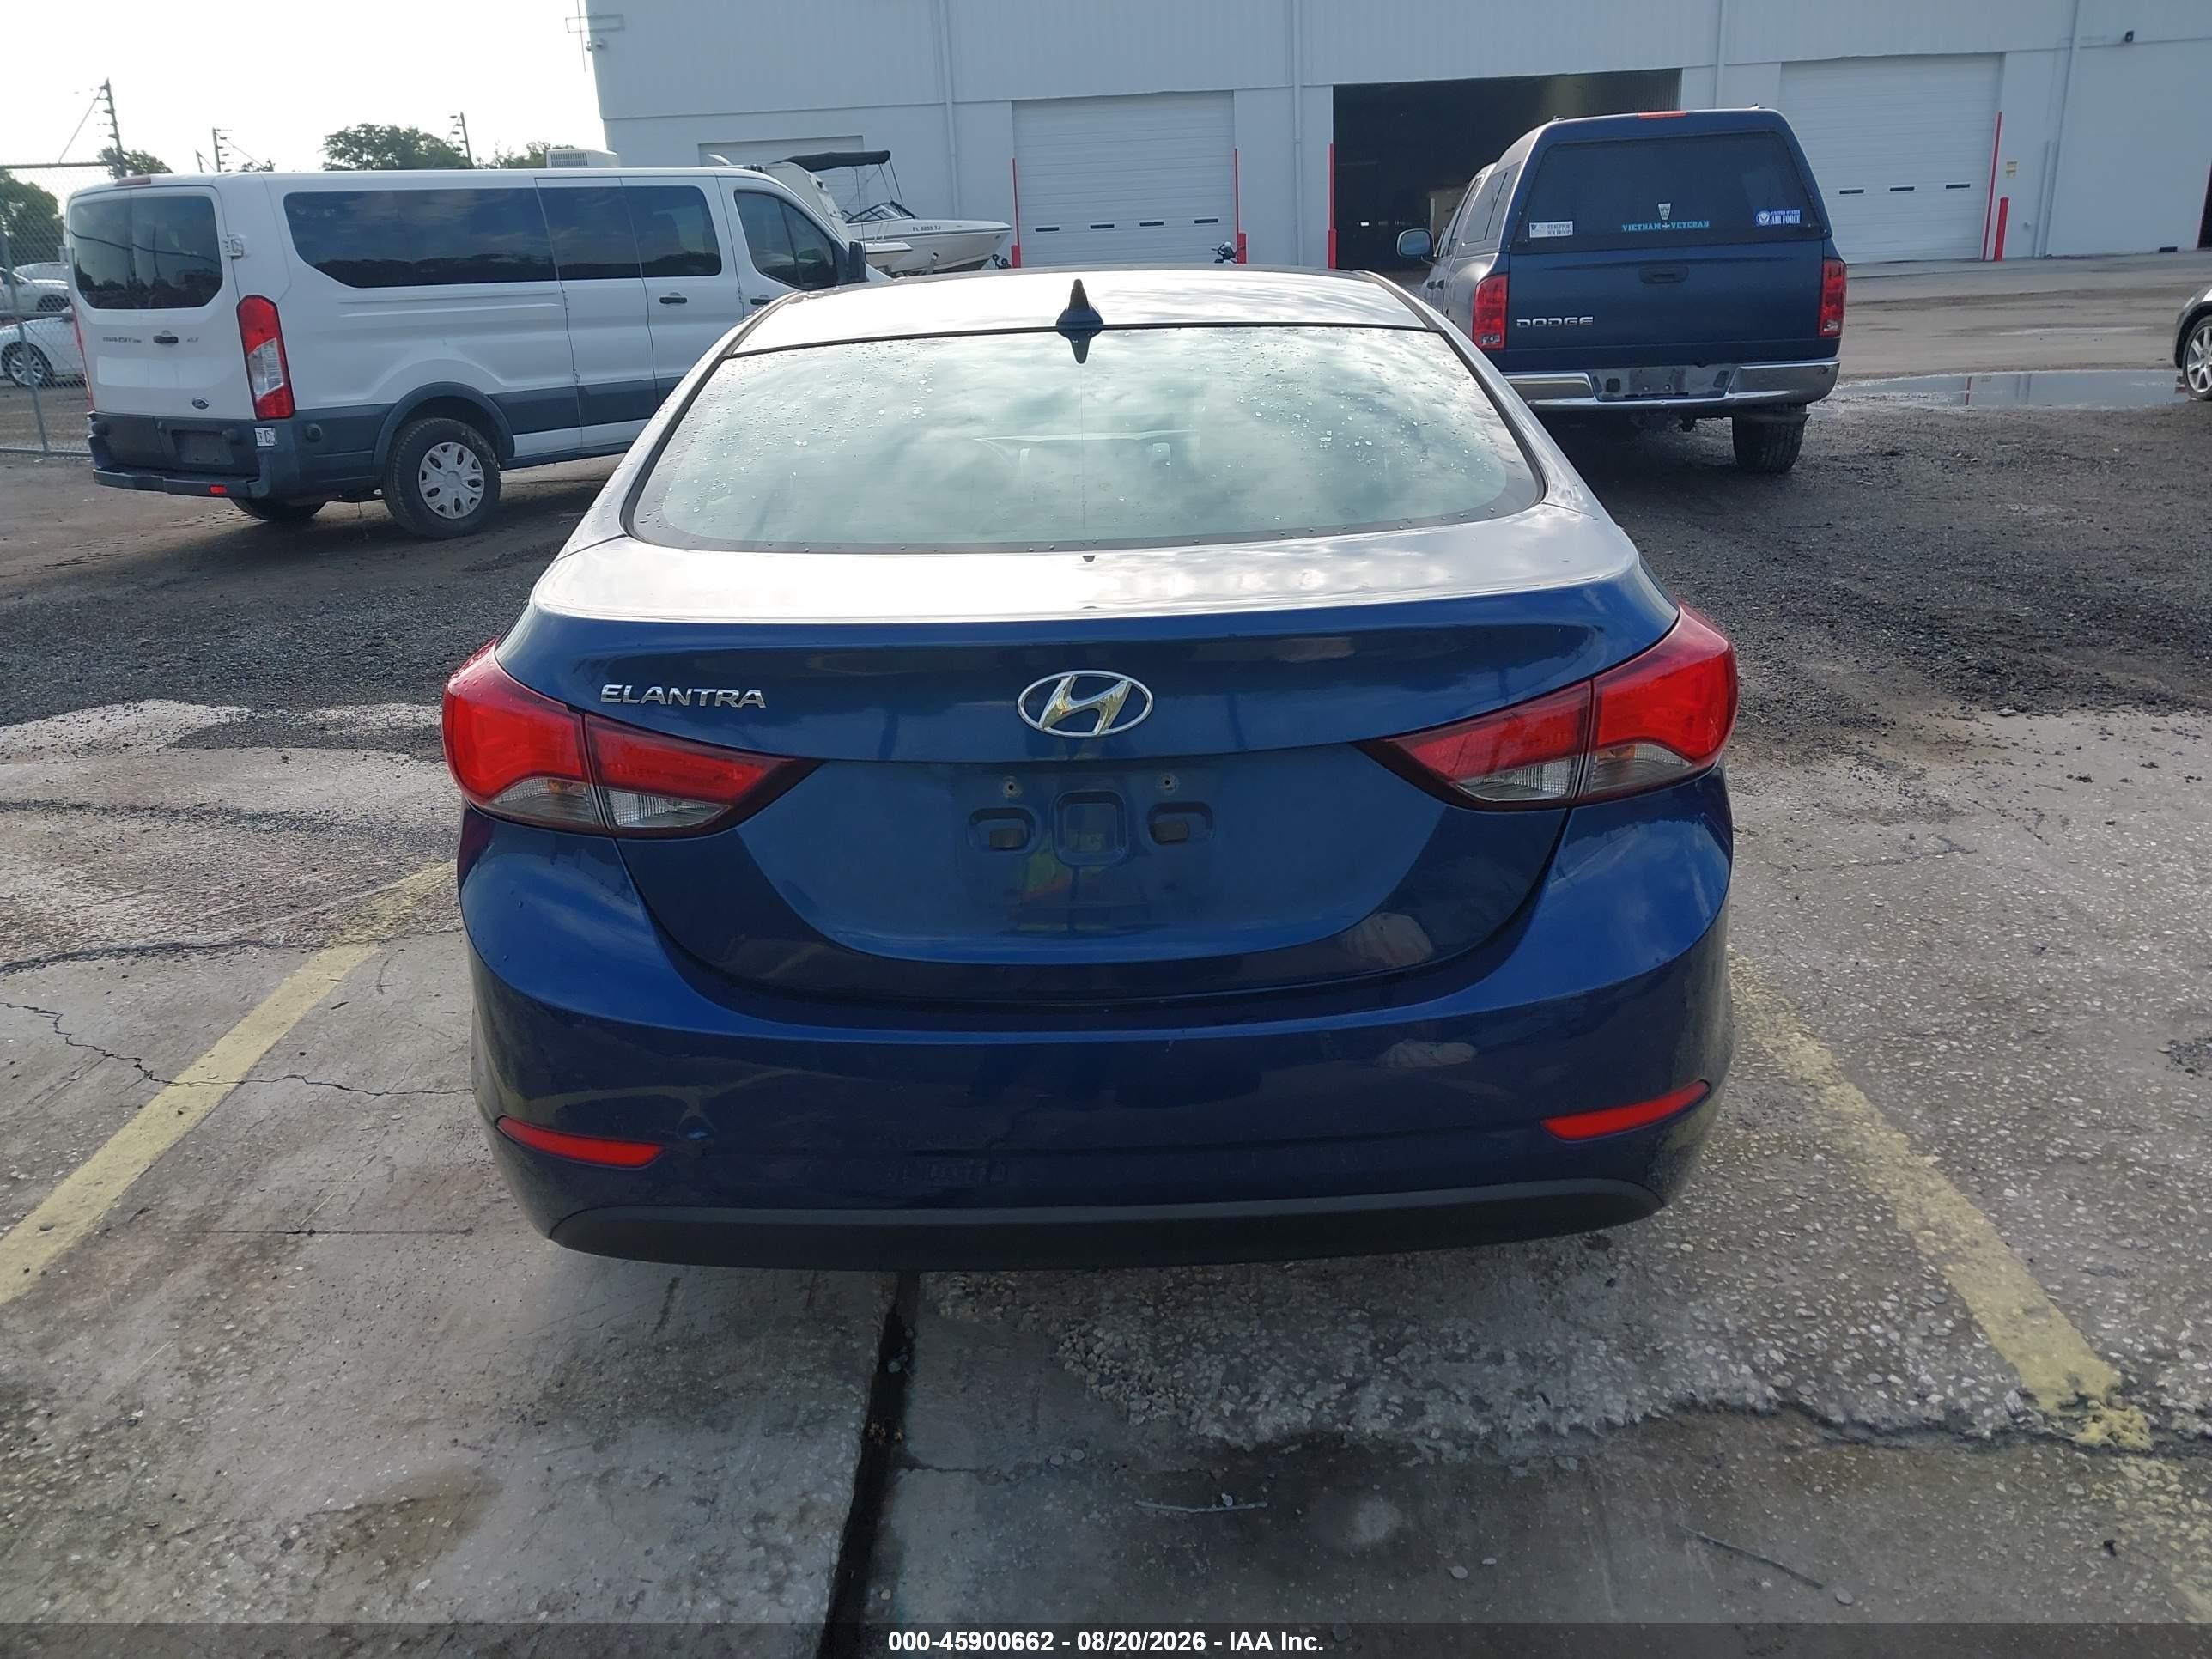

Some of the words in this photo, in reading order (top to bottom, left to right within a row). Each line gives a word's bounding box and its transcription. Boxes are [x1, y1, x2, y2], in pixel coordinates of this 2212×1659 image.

[1771, 215, 1782, 225] AIR
[1782, 214, 1801, 224] FORCE
[1622, 222, 1662, 232] VIETNAM
[1670, 220, 1710, 228] VETERAN
[1516, 316, 1594, 327] DODGE
[600, 684, 767, 708] ELANTRA
